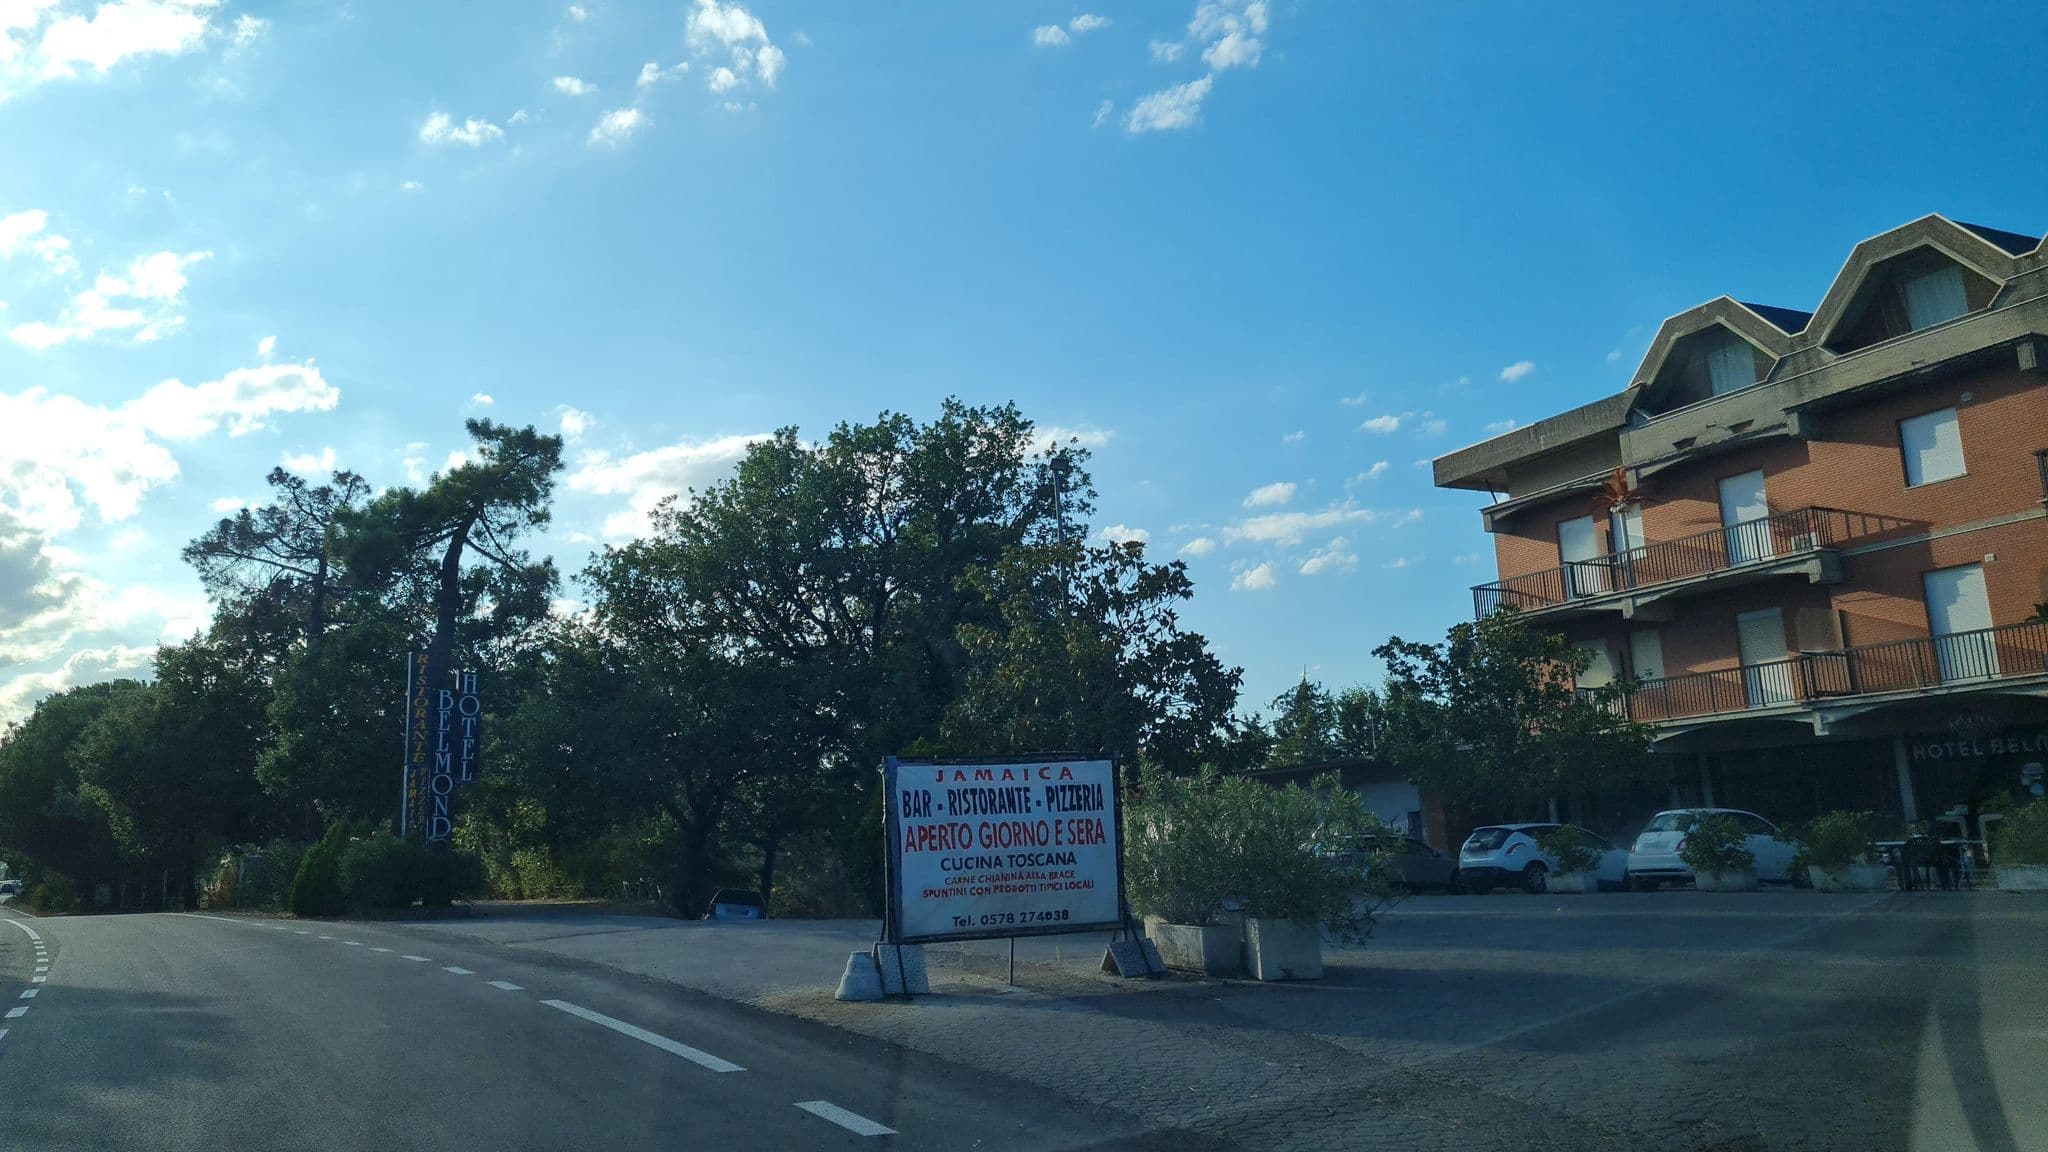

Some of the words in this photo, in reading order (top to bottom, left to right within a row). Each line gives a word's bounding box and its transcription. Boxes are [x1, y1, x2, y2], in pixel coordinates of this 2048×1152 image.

[414, 654, 429, 763] RISTORANTE
[459, 674, 480, 782] HOTEL
[1912, 737, 1985, 760] HOTEL
[430, 689, 454, 840] BELMOND
[936, 767, 1073, 783] JAMAICA
[902, 789, 932, 818] BAR
[947, 786, 1031, 817] RISTORANTE
[1045, 783, 1105, 813] PIZZERIA
[905, 822, 973, 853] APERTO
[978, 819, 1049, 850] GIORNO
[1055, 820, 1063, 846] E
[1067, 818, 1106, 845] SERA
[940, 854, 1003, 872] CUCINA
[1007, 851, 1077, 868] TOSCANA
[922, 887, 967, 898] SPUNTINI
[969, 886, 991, 897] CON
[993, 883, 1037, 894] PRODOTTI
[1039, 881, 1063, 892] TIPICI
[1064, 879, 1094, 890] LOCALI
[944, 875, 976, 886] CARNE
[977, 872, 1025, 884] CHIANINA
[1025, 871, 1047, 881] ALLA
[1048, 870, 1076, 880] BRACE
[951, 915, 975, 928] Tel.
[980, 912, 1015, 926] 0578
[1019, 909, 1070, 924] 274038
